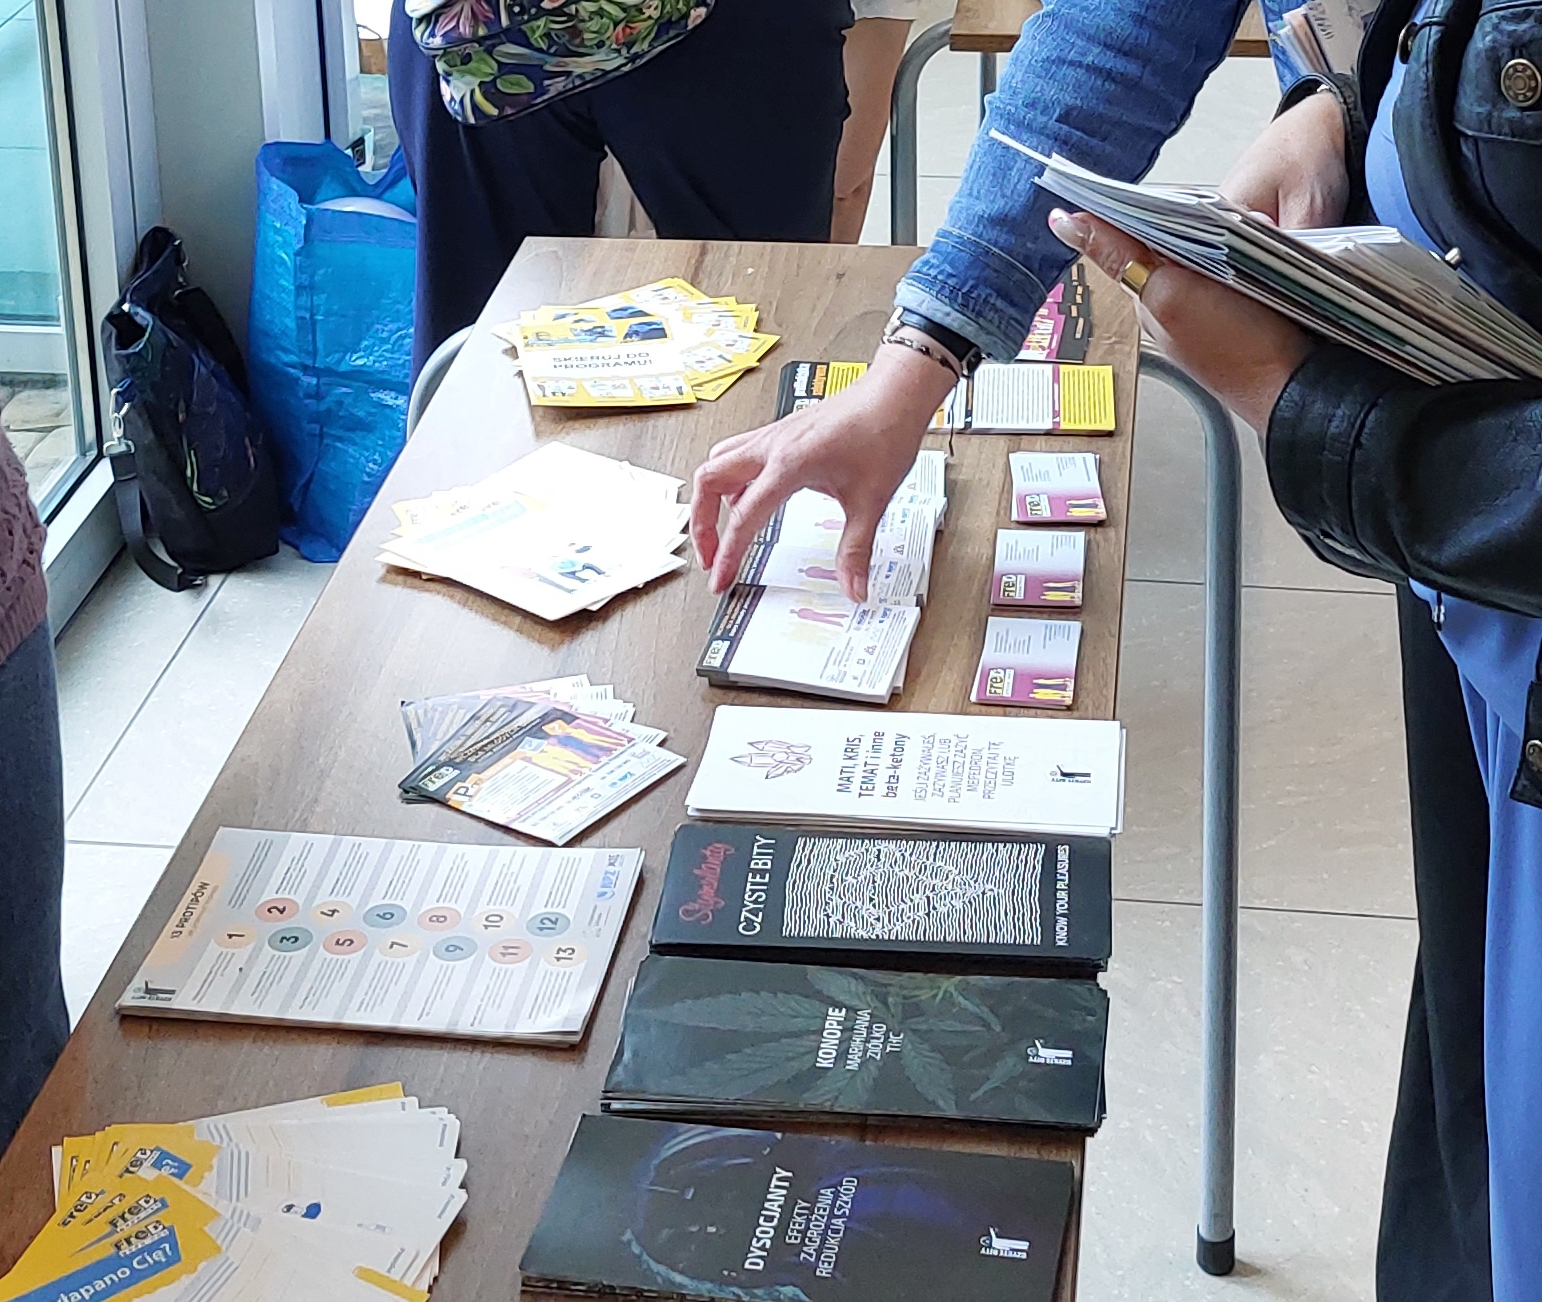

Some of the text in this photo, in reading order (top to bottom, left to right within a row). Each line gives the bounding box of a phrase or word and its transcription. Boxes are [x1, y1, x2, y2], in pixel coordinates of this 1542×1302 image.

[866, 731, 885, 753] inne
[836, 734, 865, 793] MATI, KRIS,
[880, 733, 911, 798] beta-ketony
[858, 761, 879, 798] TEMAT
[739, 834, 776, 935] CZYSTE BITY
[178, 881, 210, 929] PROTIPÓW
[267, 904, 286, 915] 2
[320, 908, 340, 918] 4
[1056, 890, 1069, 915] YOUR
[377, 911, 395, 921] 6
[429, 914, 447, 924] 8
[484, 913, 504, 930] 10
[536, 916, 559, 932] 12
[227, 931, 245, 940] 1
[279, 935, 299, 944] 3
[335, 937, 355, 947] 5
[1055, 917, 1069, 946] KNOW
[389, 941, 408, 950] 7
[445, 944, 464, 953] 9
[500, 945, 520, 957] 11
[555, 947, 575, 962] 13
[816, 1007, 846, 1068] KONOPIE
[845, 1009, 871, 1070] MARIHUANA
[885, 1032, 904, 1054] THC
[744, 1166, 794, 1271] DYSOCJANTY
[785, 1199, 811, 1245] EFEKTY
[799, 1187, 836, 1263] ZAGROŻENIA
[815, 1177, 858, 1278] REDUKCJA SZKÓD
